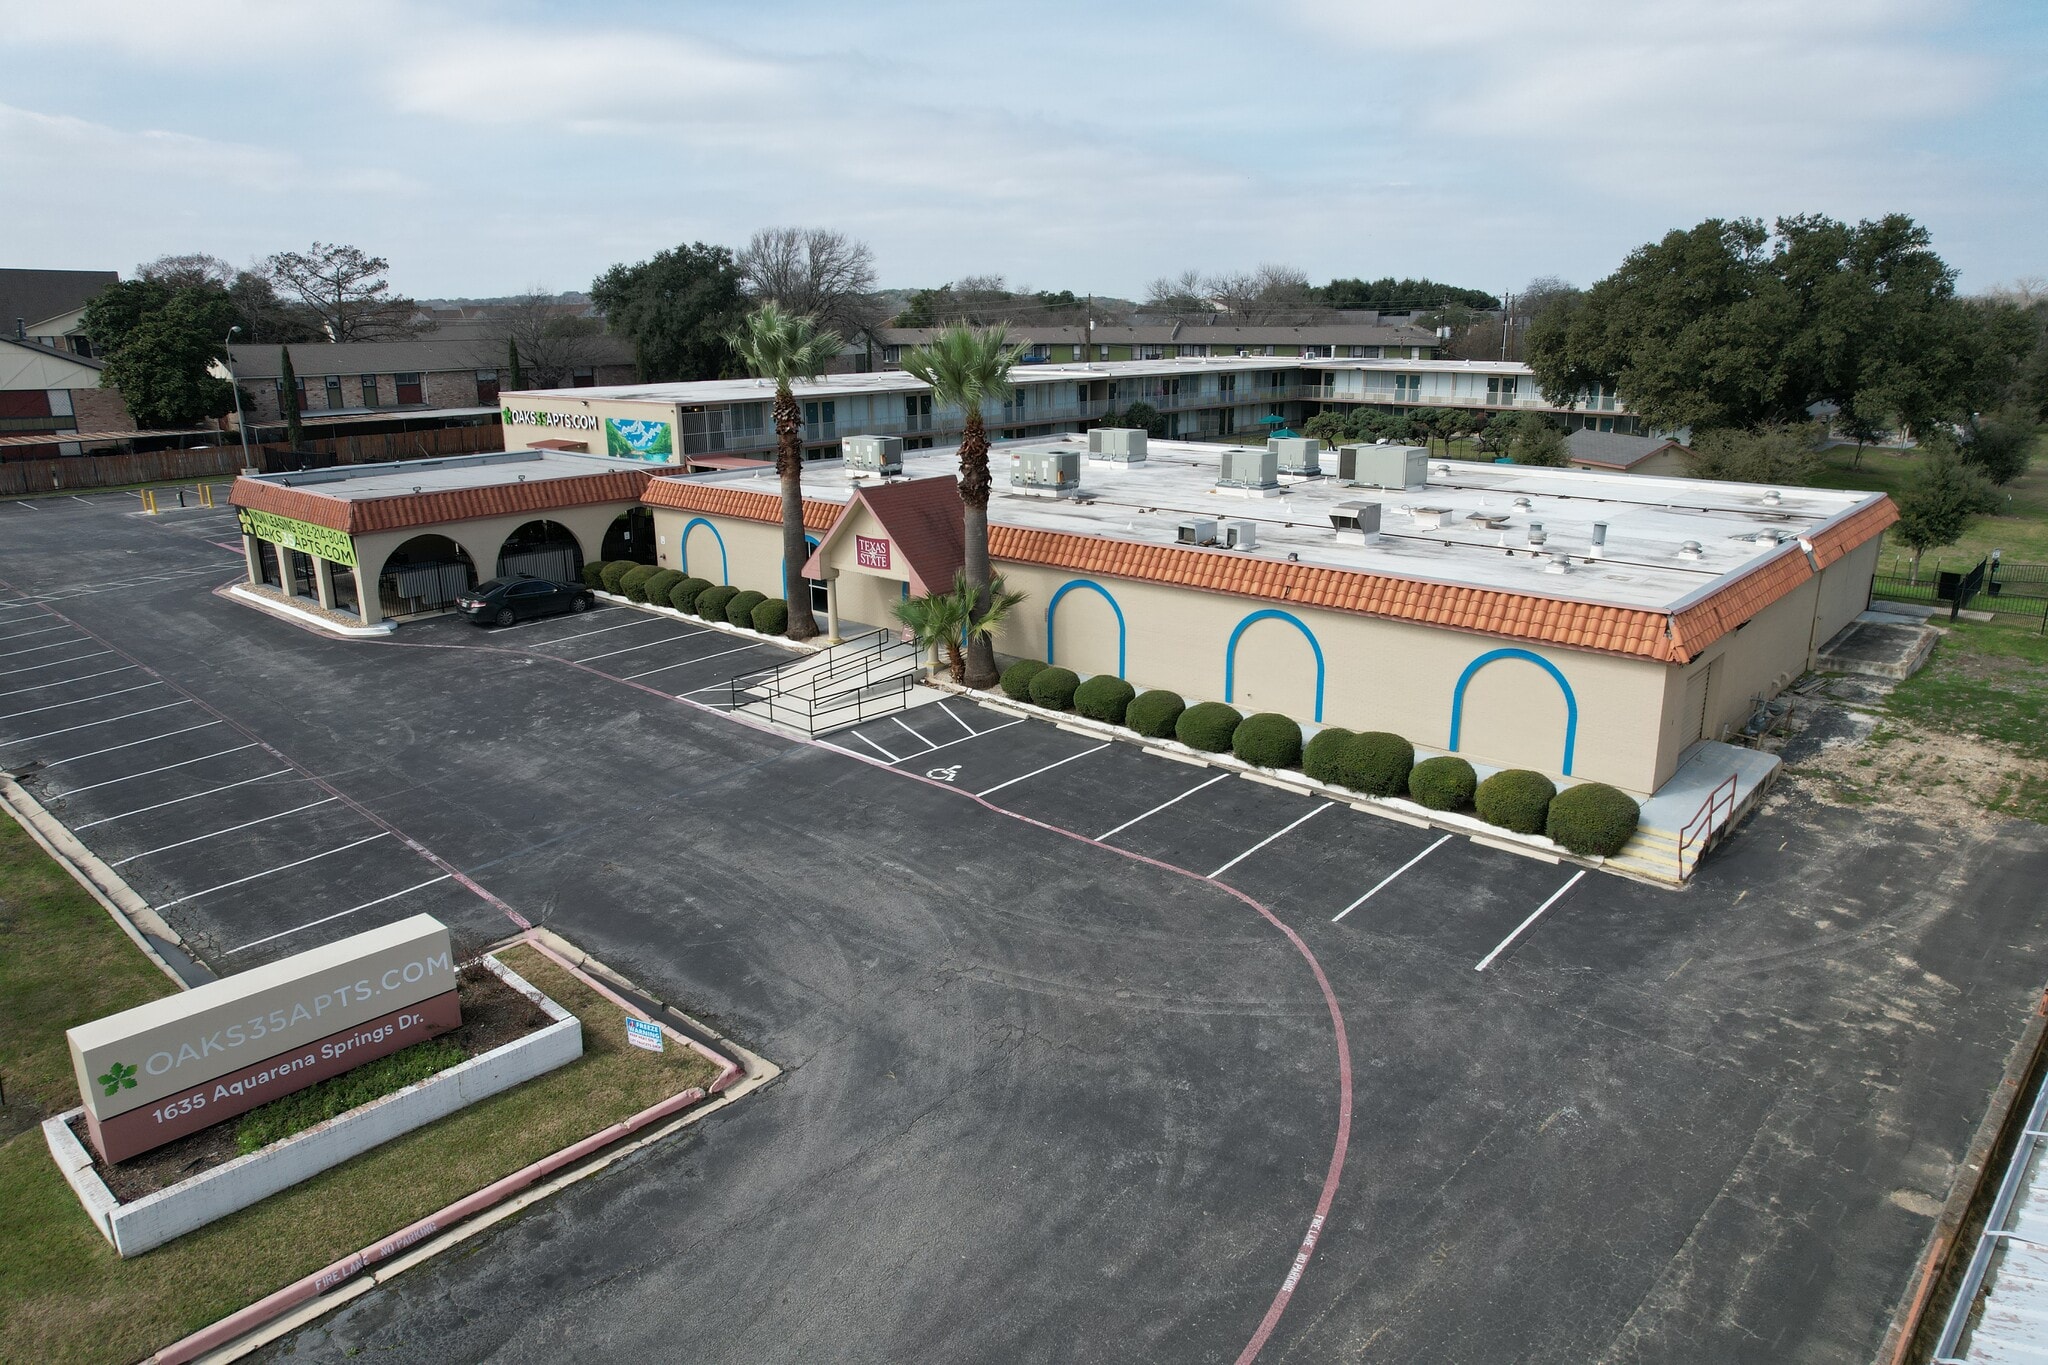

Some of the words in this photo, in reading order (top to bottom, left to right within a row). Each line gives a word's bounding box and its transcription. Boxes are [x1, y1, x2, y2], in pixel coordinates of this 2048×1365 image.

[512, 410, 599, 430] OAKS35APTS.COM
[249, 509, 268, 526] NOW
[268, 515, 296, 534] LEASING
[296, 522, 349, 548] 512-214-8041
[256, 524, 354, 565] OAKS35APTS.COM
[859, 539, 886, 553] TEXAS
[860, 553, 887, 567] STATE
[144, 951, 450, 1077] OAKS35APTS.COM
[636, 1022, 659, 1032] FREEZE
[629, 1026, 660, 1039] WARNING
[152, 1093, 206, 1124] 1635
[212, 1054, 316, 1102] Aquarena
[321, 1022, 394, 1060] Springs
[398, 1012, 424, 1031] Dr.
[315, 1273, 341, 1291] FIRE
[342, 1254, 371, 1277] LANE
[380, 1244, 395, 1257] NO
[396, 1222, 437, 1250] PARKING
[1282, 1262, 1303, 1292] PARKING
